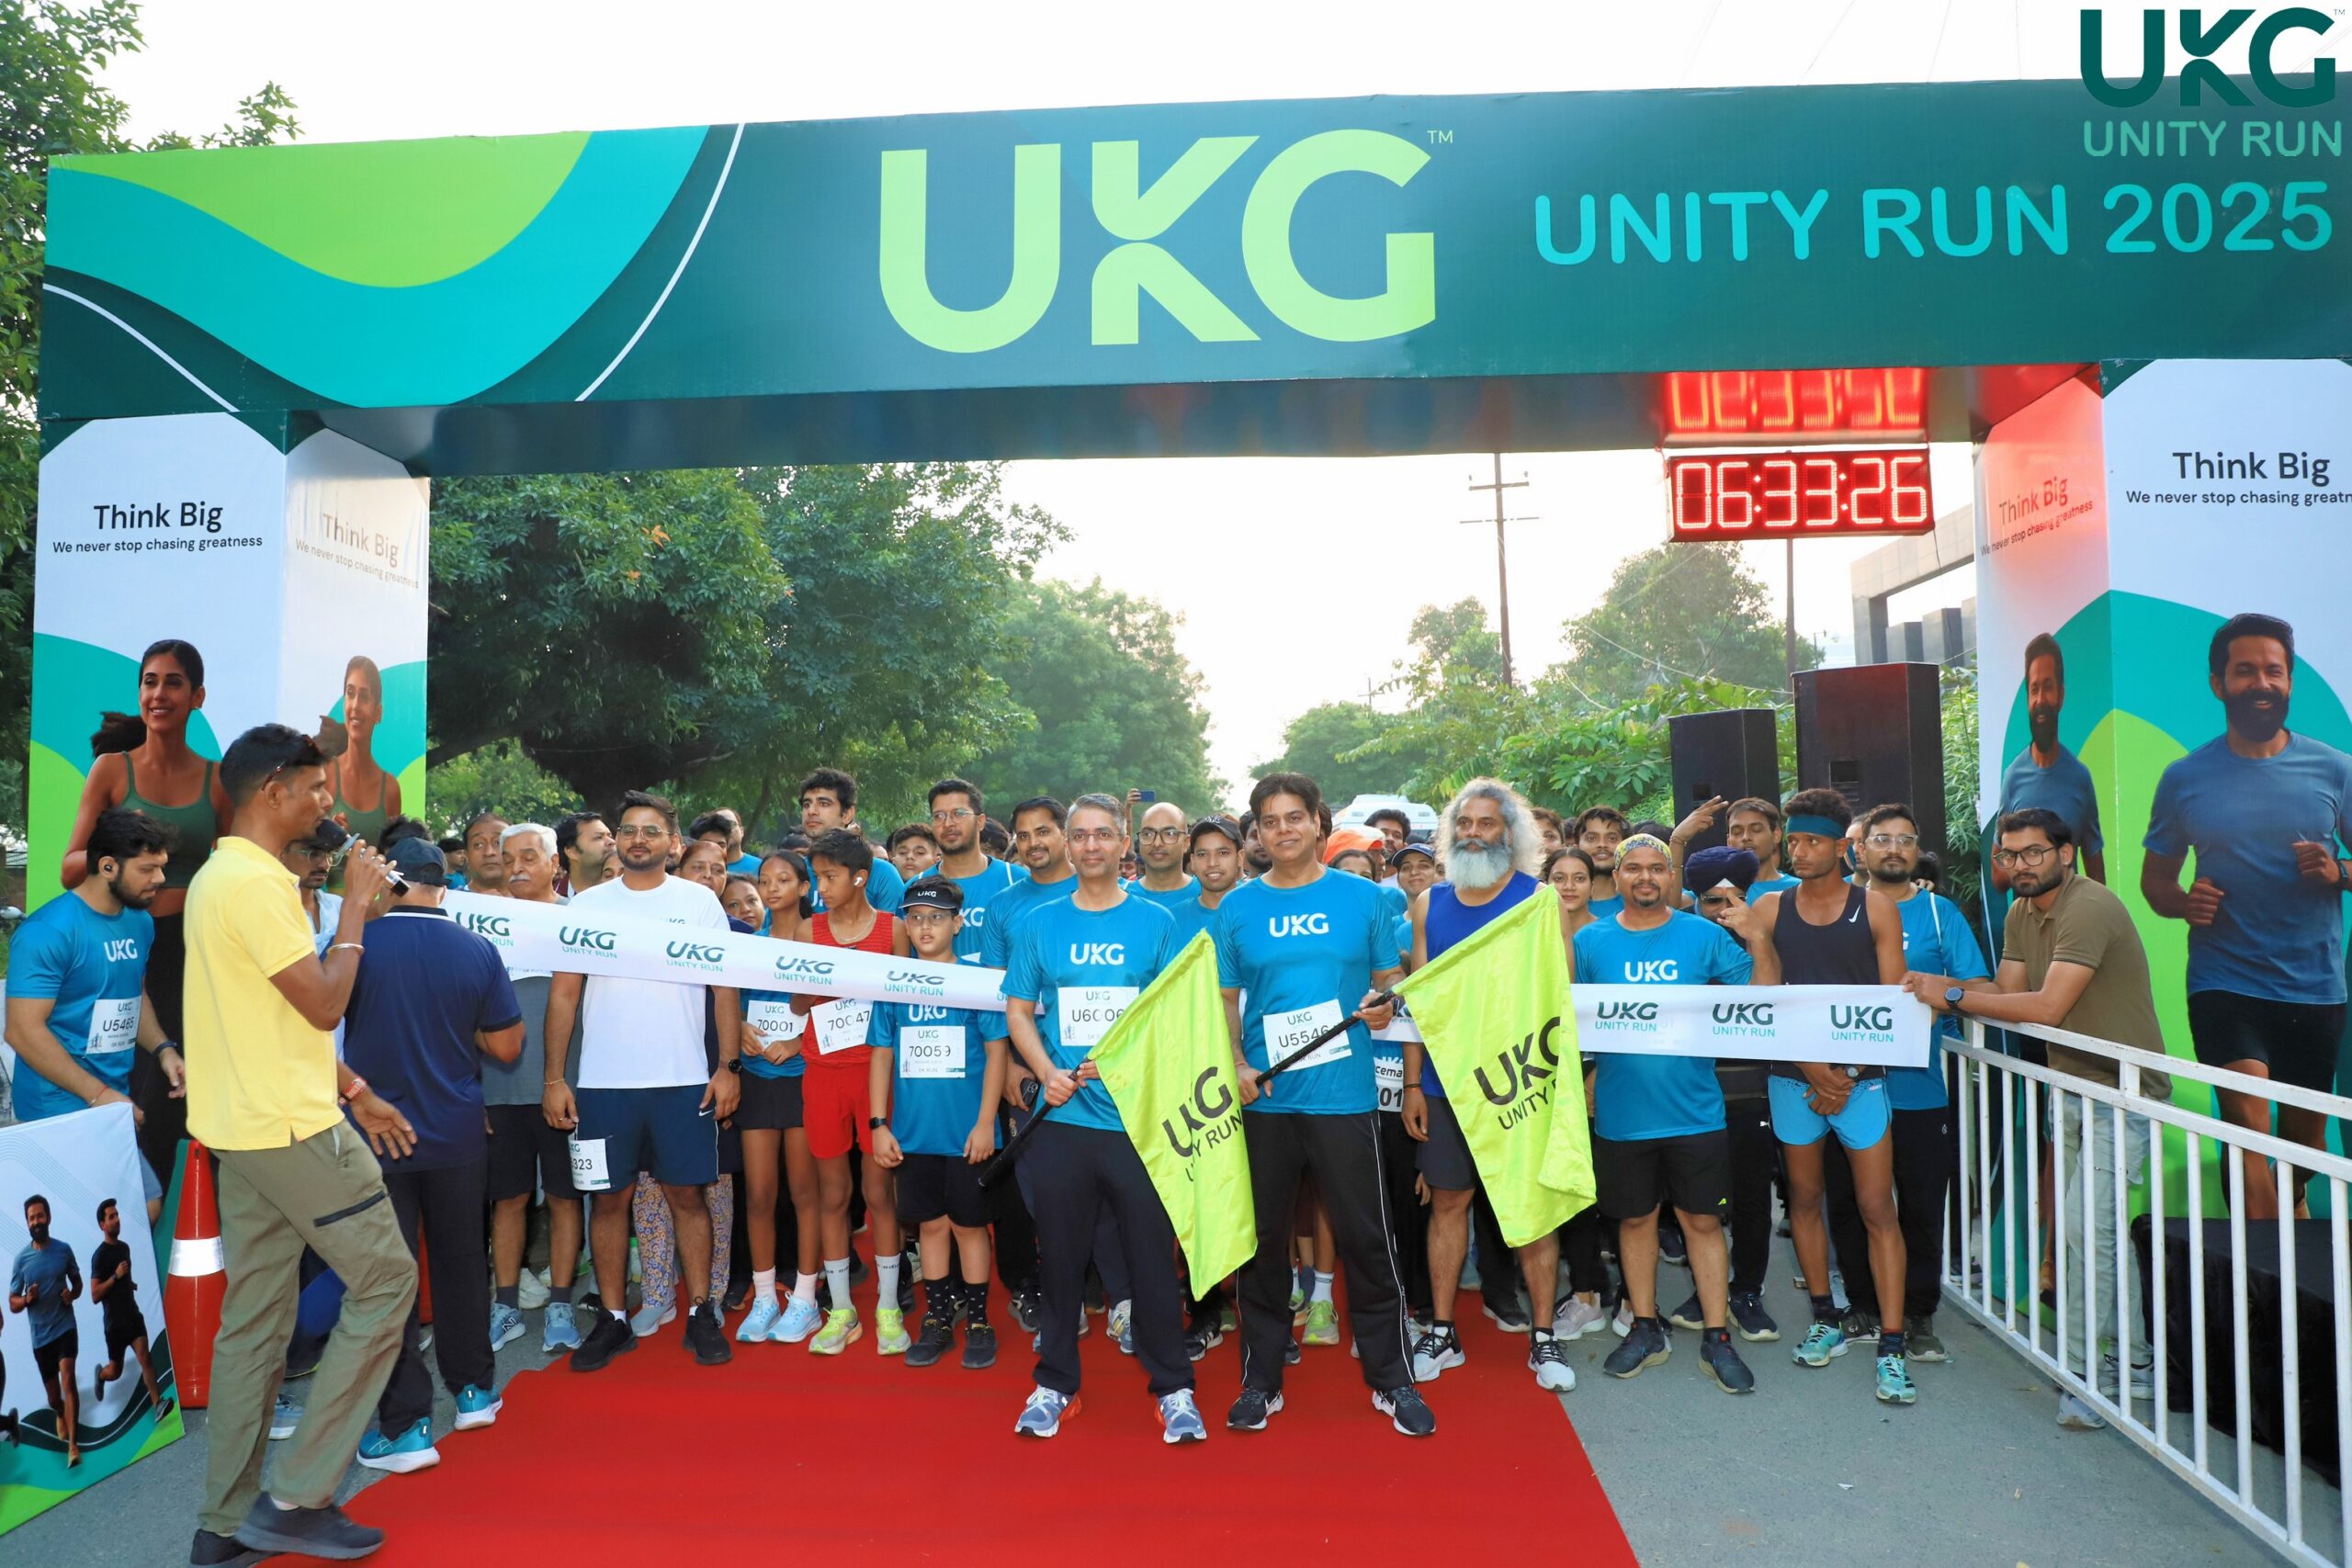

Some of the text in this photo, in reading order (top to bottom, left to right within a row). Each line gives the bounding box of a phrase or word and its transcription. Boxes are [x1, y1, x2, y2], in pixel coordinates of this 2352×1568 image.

[1535, 181, 2334, 265] UNITY RUN 2025
[879, 129, 1436, 353] UKG
[2172, 451, 2331, 487] Think Big
[1677, 457, 1927, 529] 06:33:26
[1998, 476, 2068, 525] Think Big
[2126, 491, 2352, 506] We never stop chasing greatn
[94, 501, 223, 533] Think Big
[1980, 501, 2093, 556] We never stop chasing greatness
[53, 536, 264, 553] We never stop chasing greatness
[323, 513, 399, 568] Think Big
[296, 538, 419, 589] We never stop chasing greatness
[456, 911, 511, 937] UKG
[958, 907, 985, 927] KG
[1270, 913, 1329, 938] UKG
[492, 938, 514, 947] RUN
[559, 926, 617, 950] UKG
[104, 938, 138, 962] UKG
[562, 945, 617, 959] UNITY RUN
[666, 941, 725, 963] UKG
[1070, 943, 1125, 965] UKG
[666, 959, 723, 972] UNITY RUN
[775, 955, 835, 975] UKG
[1624, 959, 1679, 982] UKG
[774, 972, 832, 986] UNITY RUN
[887, 970, 945, 986] UKG
[884, 983, 944, 997] UNITY RUN
[1086, 990, 1111, 1001] UKG
[118, 1001, 133, 1012] UKG
[764, 1005, 786, 1014] UKG
[835, 998, 856, 1011] UKG
[909, 1004, 947, 1021] UKG
[1597, 1001, 1659, 1021] UKG
[1713, 1003, 1774, 1025] UKG
[757, 1019, 793, 1032] 70001
[1287, 1011, 1313, 1025] UKG
[1595, 1021, 1657, 1032] UNITY RUN
[1830, 1005, 1893, 1031] UKG
[918, 1030, 939, 1039] UKG
[1279, 1025, 1329, 1047] U5546
[1713, 1026, 1776, 1037] UNITY RUN
[1831, 1031, 1894, 1043] UNITY RUN
[1374, 1066, 1403, 1077] cema
[1379, 1087, 1403, 1108] 01
[1162, 1066, 1233, 1157] UKG
[1498, 1086, 1549, 1130] UNITY
[1205, 1110, 1242, 1149] RUN
